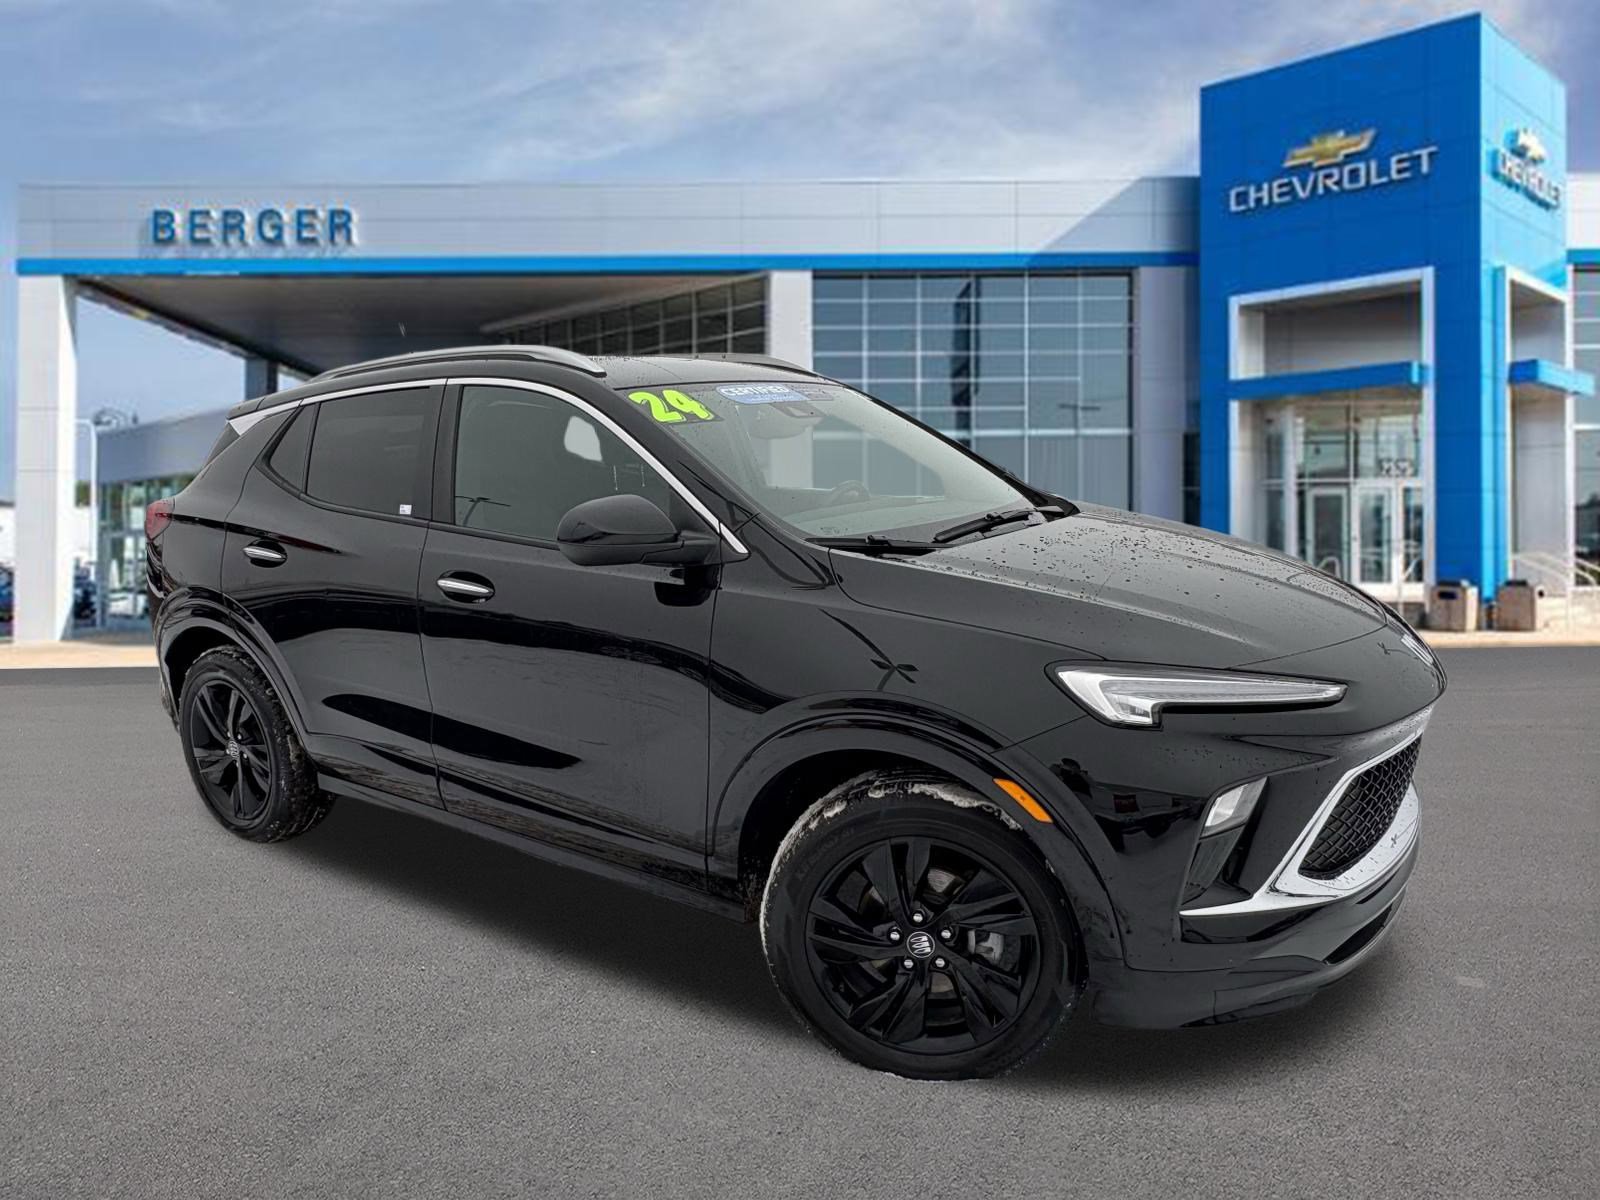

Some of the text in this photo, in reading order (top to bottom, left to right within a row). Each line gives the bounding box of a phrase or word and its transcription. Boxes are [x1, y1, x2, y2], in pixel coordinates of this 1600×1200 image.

[1229, 146, 1438, 213] CHEVROLET
[151, 207, 355, 246] BERGER
[628, 389, 715, 422] 24
[719, 384, 790, 397] CERTIFIED
